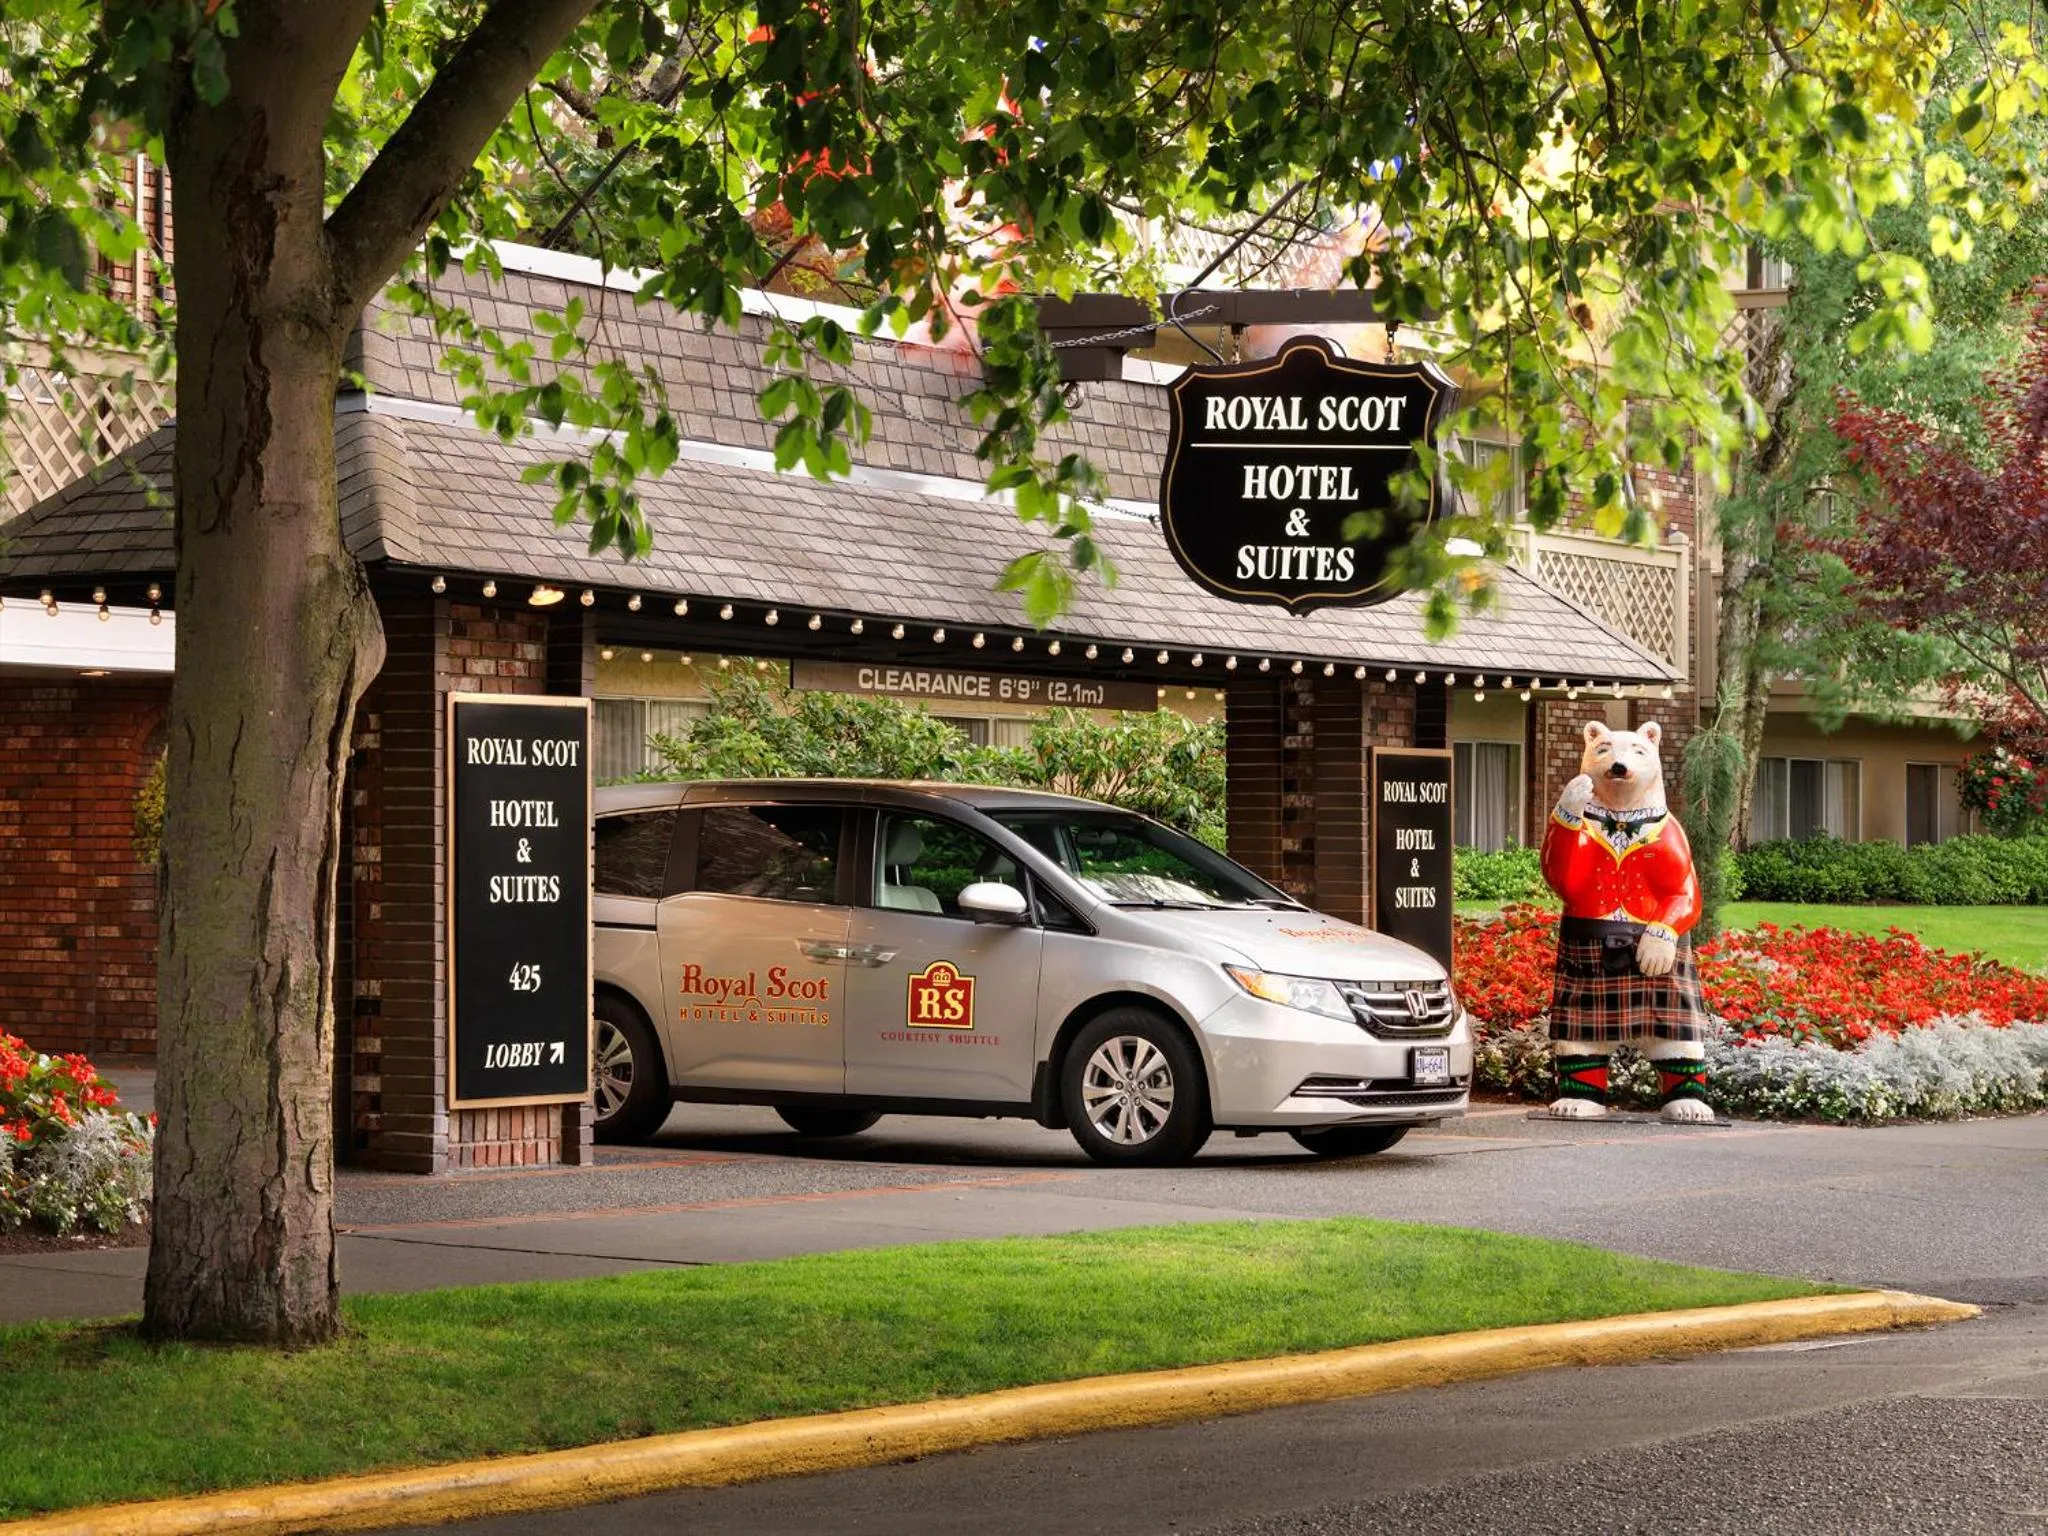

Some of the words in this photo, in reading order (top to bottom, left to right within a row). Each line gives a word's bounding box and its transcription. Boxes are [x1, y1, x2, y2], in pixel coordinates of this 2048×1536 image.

[1204, 395, 1308, 431] ROYAL
[1317, 395, 1407, 432] SCOT
[1241, 464, 1359, 501] HOTEL
[1284, 507, 1311, 537] &
[1236, 544, 1355, 582] SUITES
[858, 668, 991, 697] CLEARANCE
[1047, 682, 1104, 705] (2.1m)
[467, 737, 527, 766] ROYAL
[531, 739, 580, 767] SCOT
[1383, 781, 1418, 803] ROYAL
[1419, 781, 1448, 804] SCOT
[490, 799, 559, 828] HOTEL
[516, 837, 532, 863] &
[1395, 828, 1436, 850] HOTEL
[1410, 857, 1420, 878] &
[489, 875, 561, 904] SUITES
[1395, 886, 1436, 909] SUITES
[508, 961, 542, 993] 425
[680, 963, 756, 1004] Royal
[766, 966, 829, 1000] Scot
[680, 1008, 741, 1022] HOTEL
[749, 1010, 759, 1022] &
[767, 1010, 829, 1025] SUITES
[917, 988, 965, 1020] RS
[880, 1031, 941, 1043] COURTESY
[948, 1033, 1001, 1046] SHUTTLE
[484, 1042, 545, 1069] LOBBY
